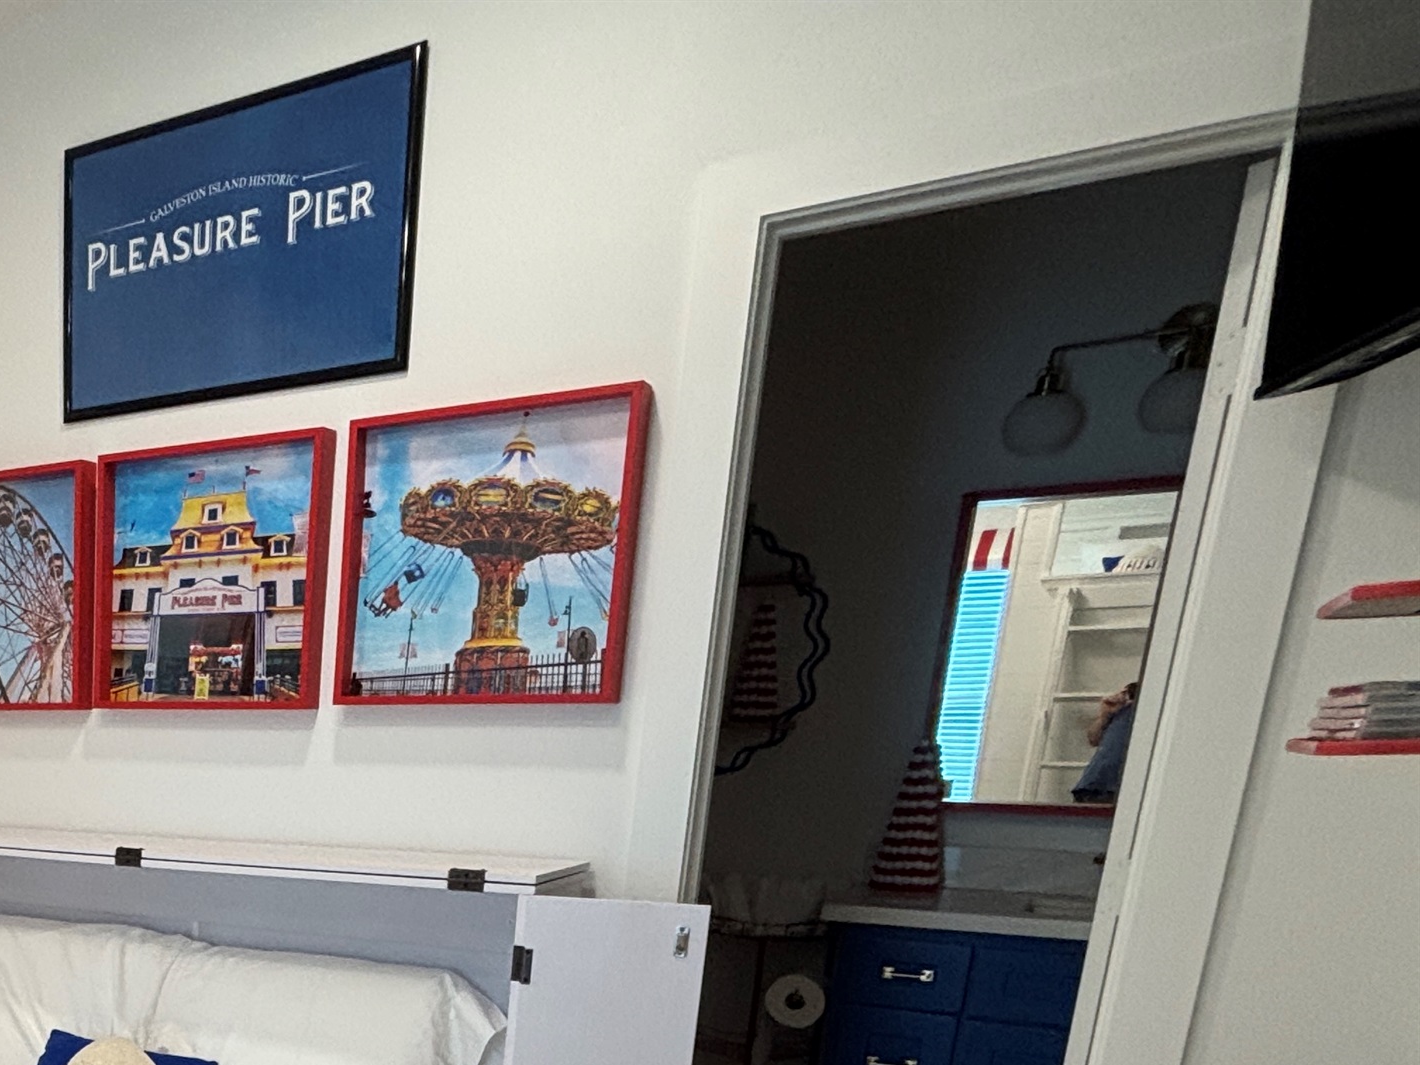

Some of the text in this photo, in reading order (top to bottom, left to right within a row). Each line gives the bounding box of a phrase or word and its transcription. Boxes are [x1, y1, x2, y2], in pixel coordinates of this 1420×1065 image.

[87, 179, 376, 292] PLEASURE PIER
[149, 173, 299, 222] GALVESTON ISLAND HISTORIC
